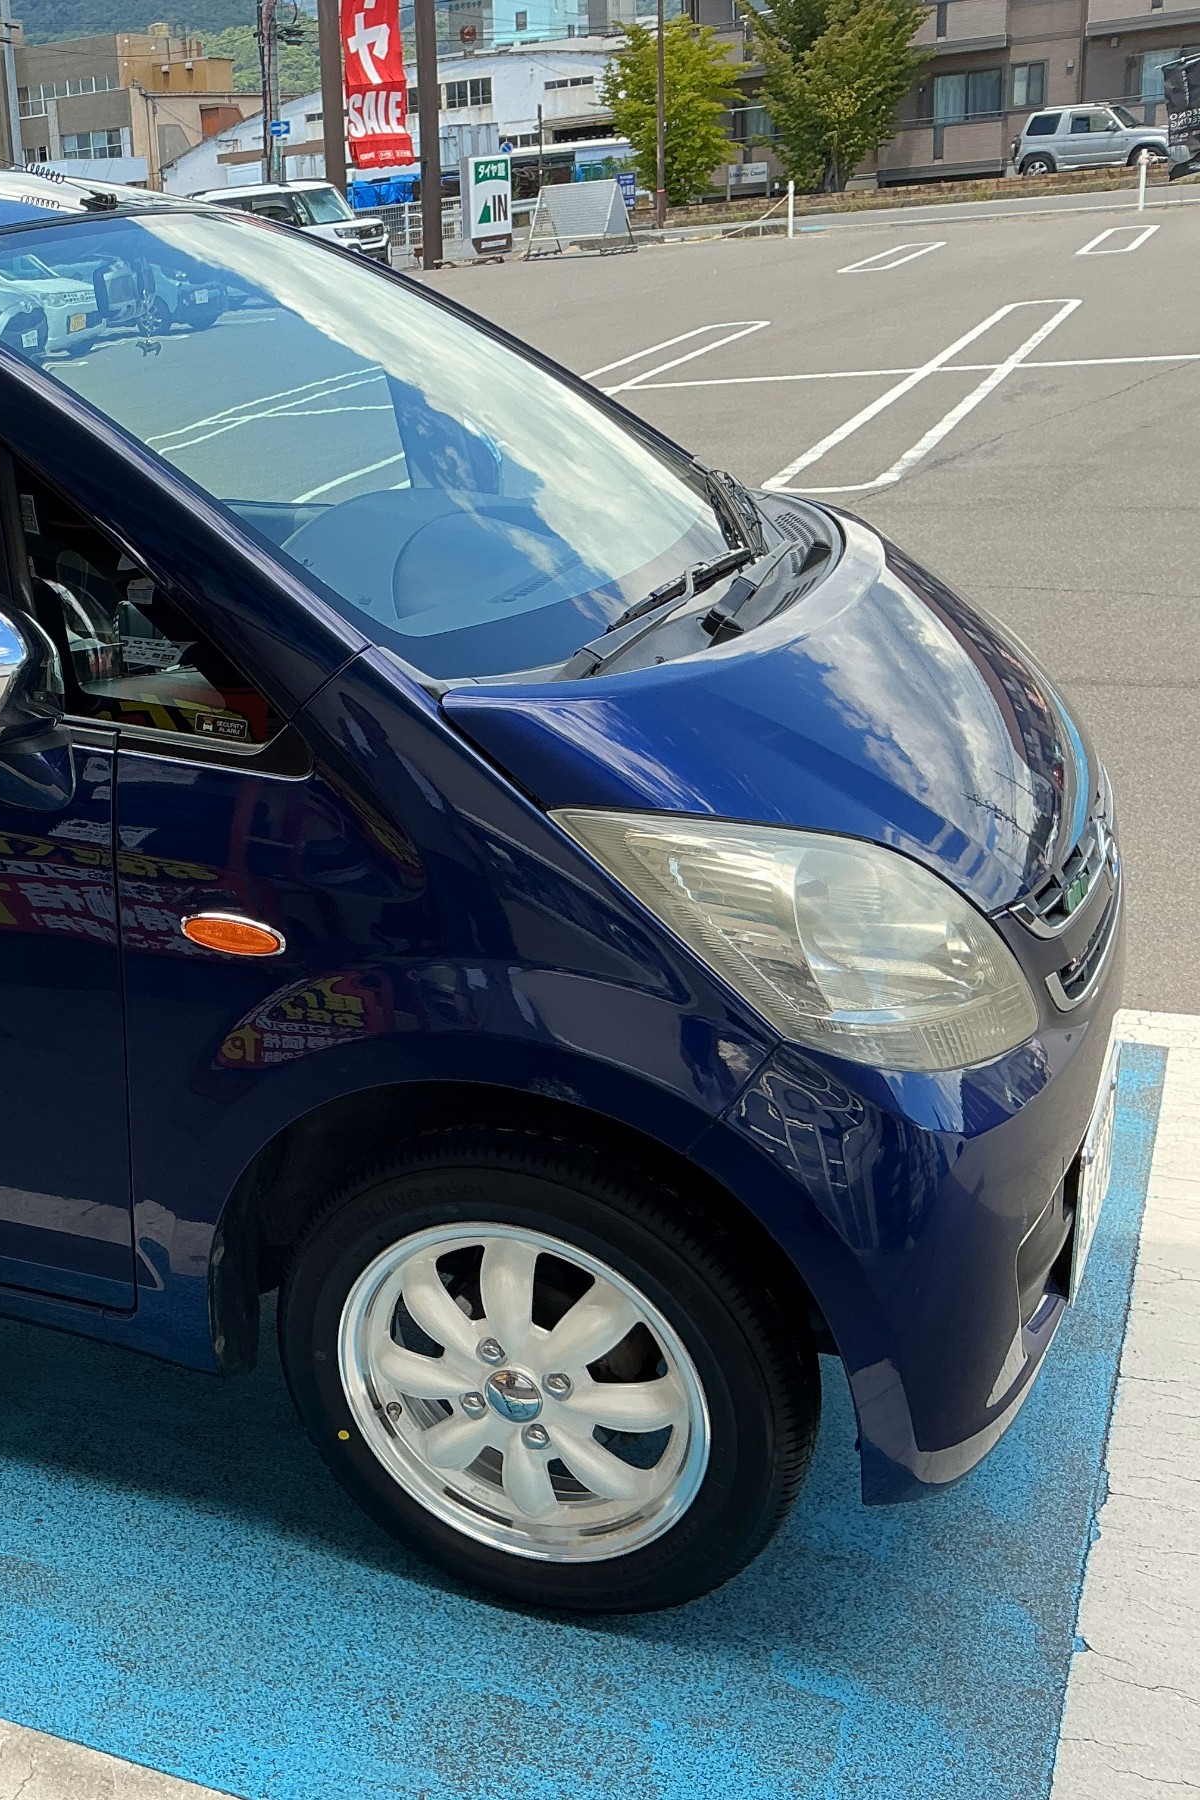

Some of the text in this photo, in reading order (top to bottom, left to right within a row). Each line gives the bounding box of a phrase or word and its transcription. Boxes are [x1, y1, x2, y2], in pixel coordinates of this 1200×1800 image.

[347, 0, 391, 86] ヤ
[348, 90, 406, 139] SALE
[478, 162, 506, 178] タイヤ館
[492, 193, 509, 223] IN
[216, 720, 245, 731] SECURITY
[218, 726, 241, 736] ALARM
